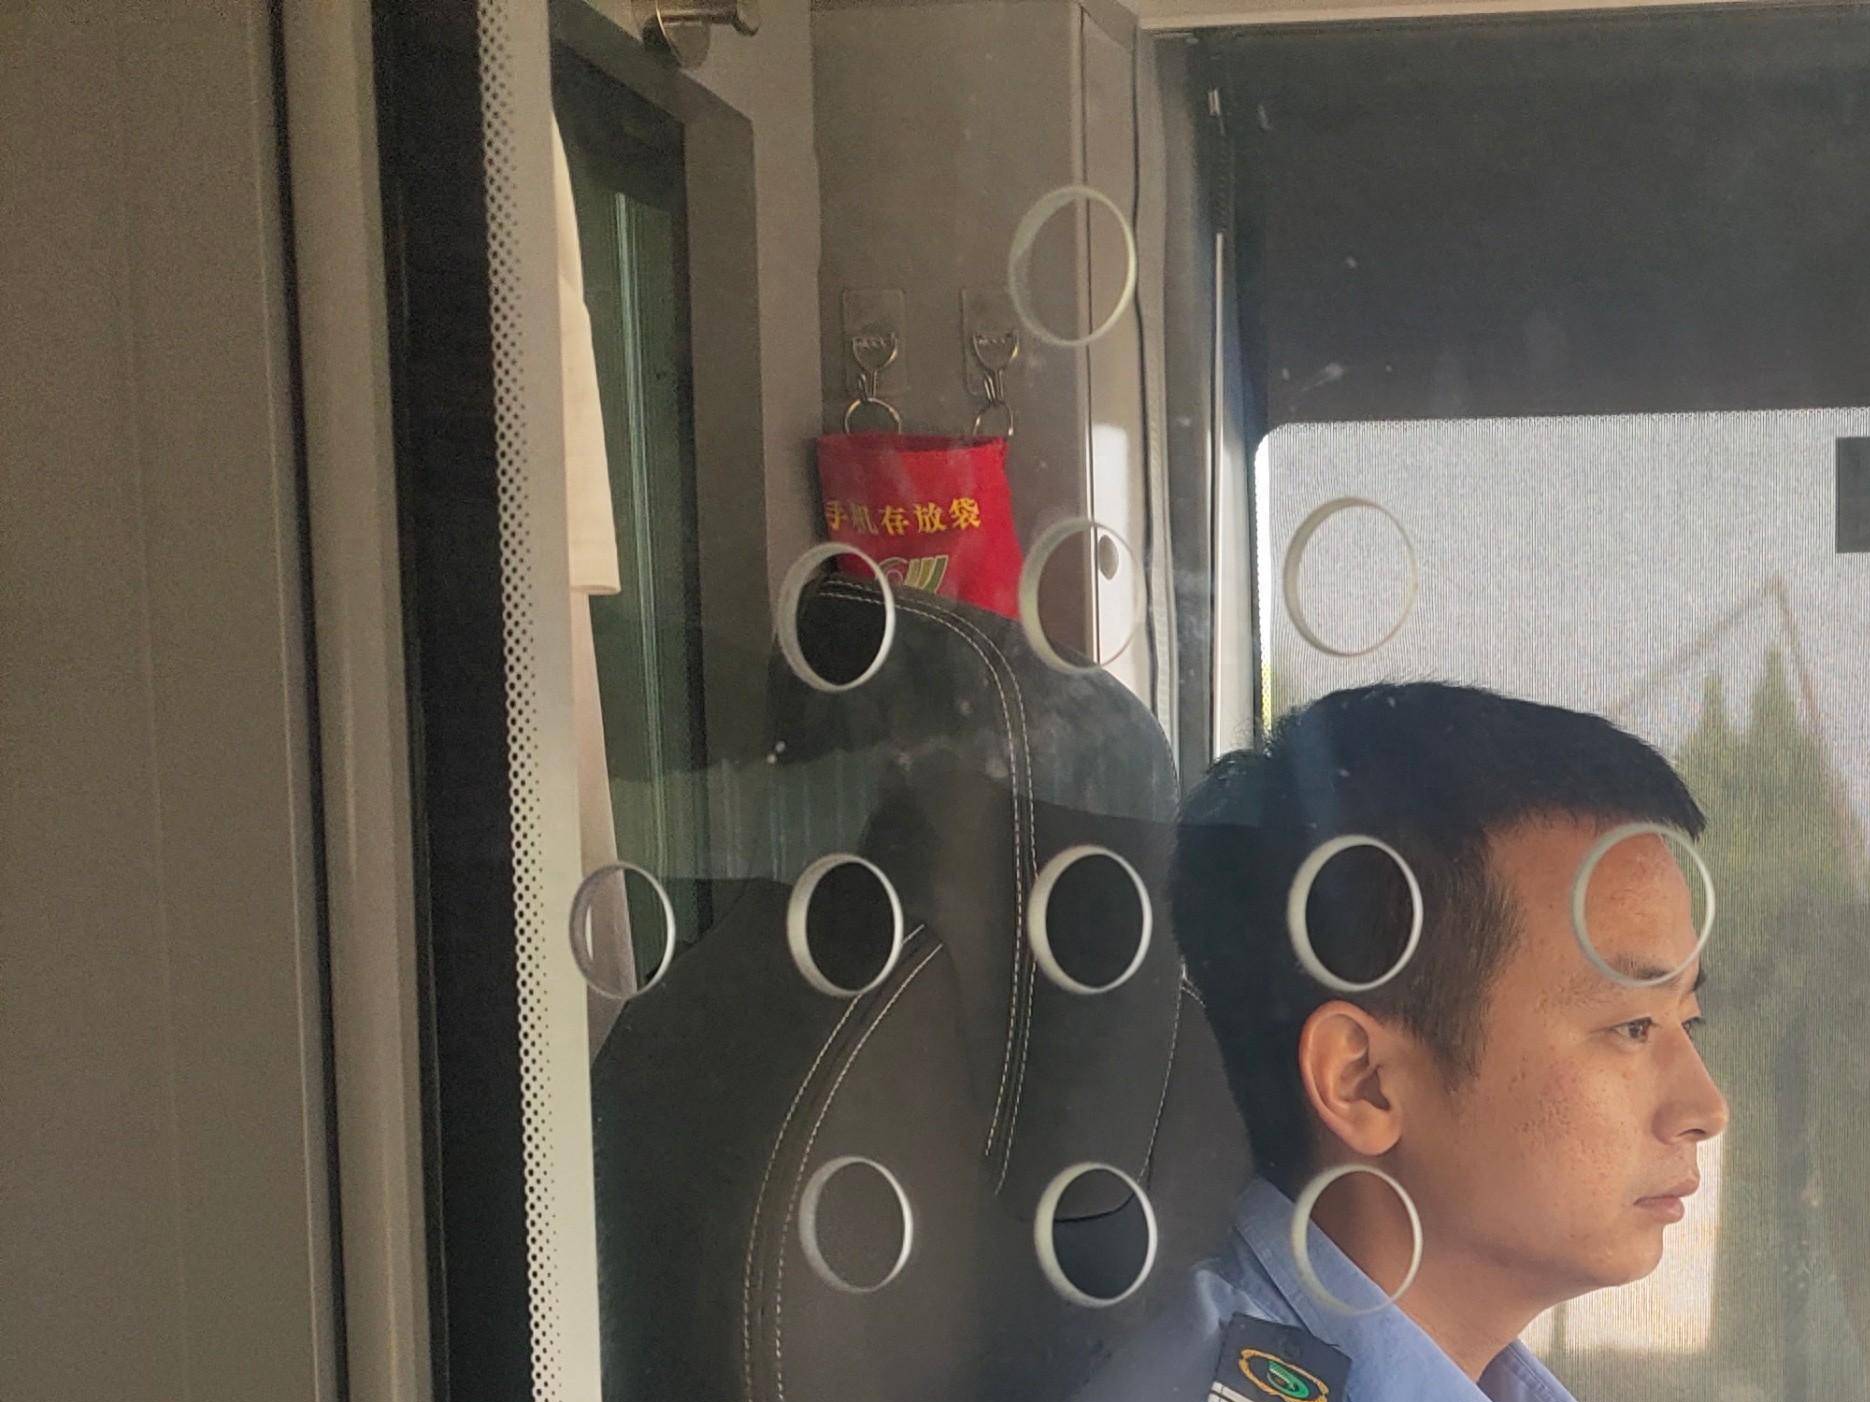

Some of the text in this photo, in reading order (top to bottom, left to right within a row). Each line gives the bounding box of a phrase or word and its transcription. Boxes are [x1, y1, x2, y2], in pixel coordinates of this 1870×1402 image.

[825, 497, 982, 535] 手机存放袋
